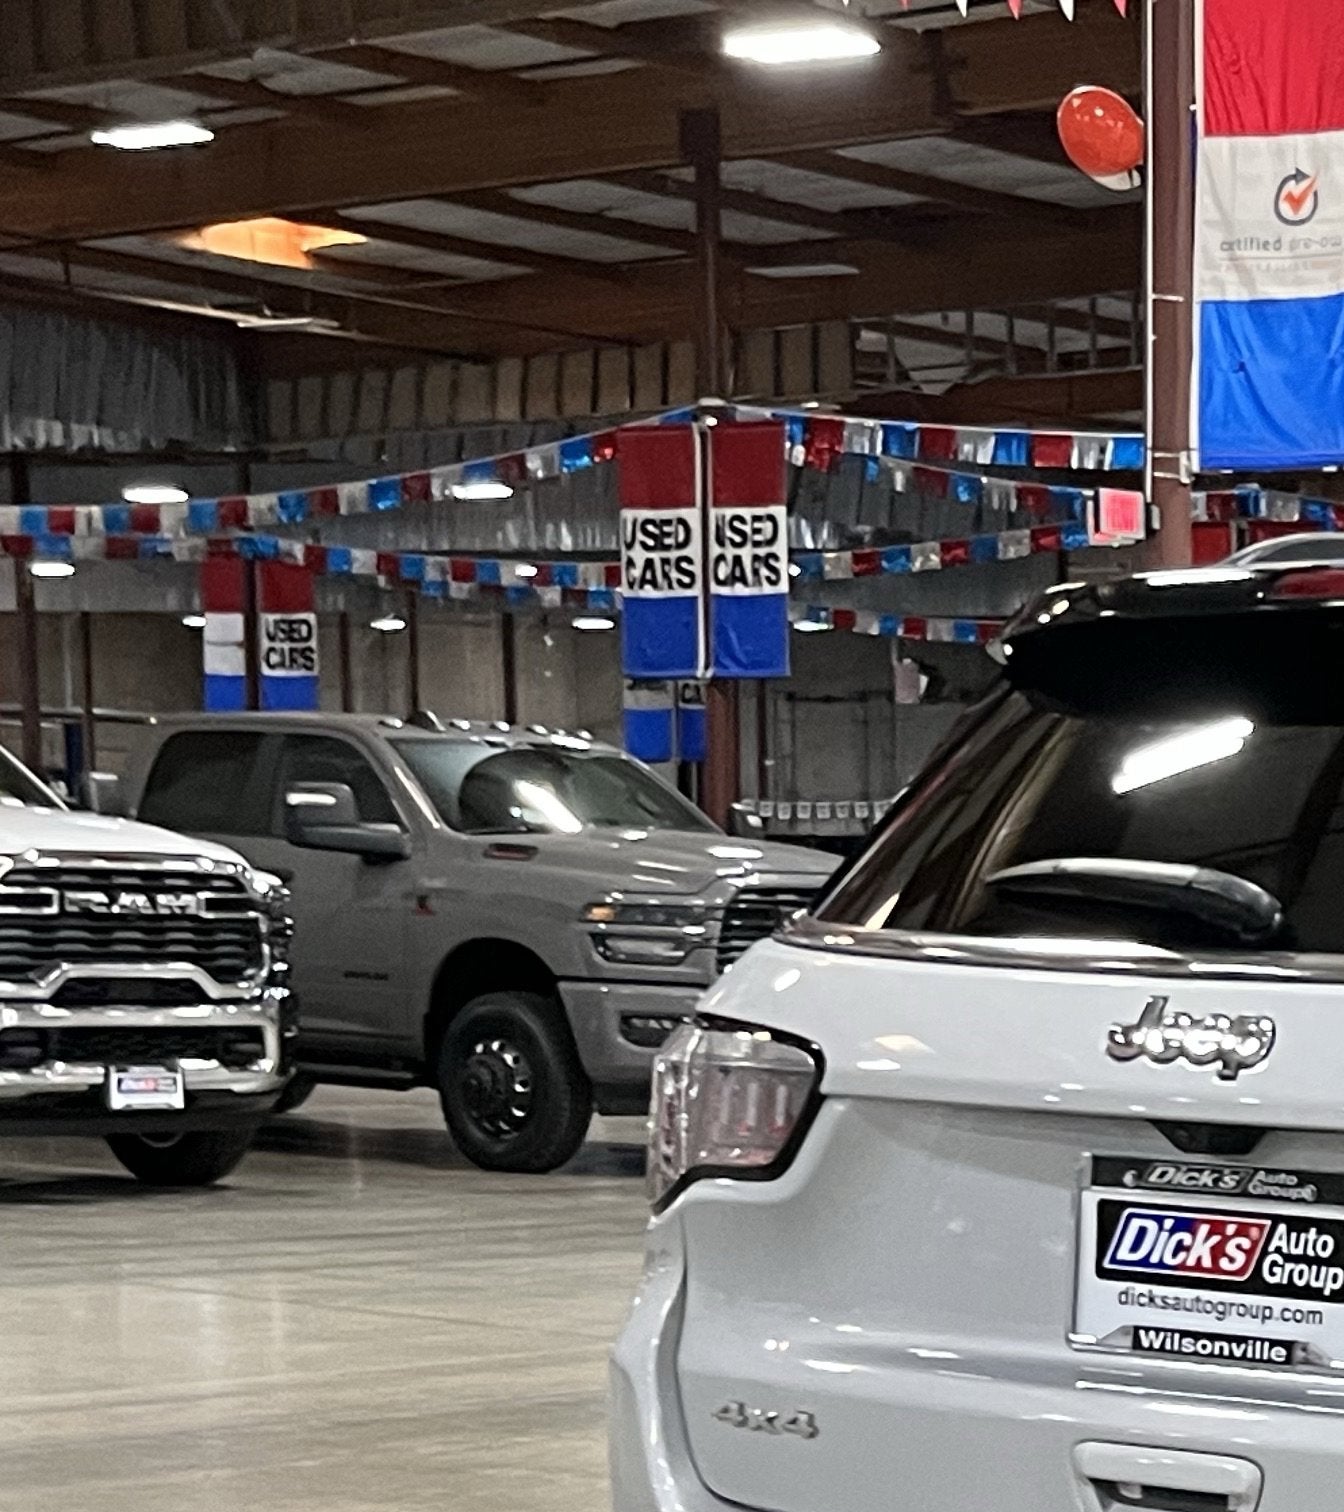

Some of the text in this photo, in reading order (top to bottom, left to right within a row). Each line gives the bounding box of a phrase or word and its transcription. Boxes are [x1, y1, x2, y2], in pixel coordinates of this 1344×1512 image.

[623, 517, 692, 552] USED
[715, 513, 779, 549] USED
[625, 555, 696, 591] CARS
[712, 552, 781, 588] CARS
[265, 618, 313, 642] USED
[1105, 994, 1277, 1081] Jeep
[1147, 1165, 1241, 1190] Dick's
[1115, 1217, 1335, 1273] Dick's Auto
[1261, 1252, 1344, 1296] Group
[1117, 1286, 1324, 1326] dicksautogroup.com
[1138, 1328, 1288, 1363] Wilsonville
